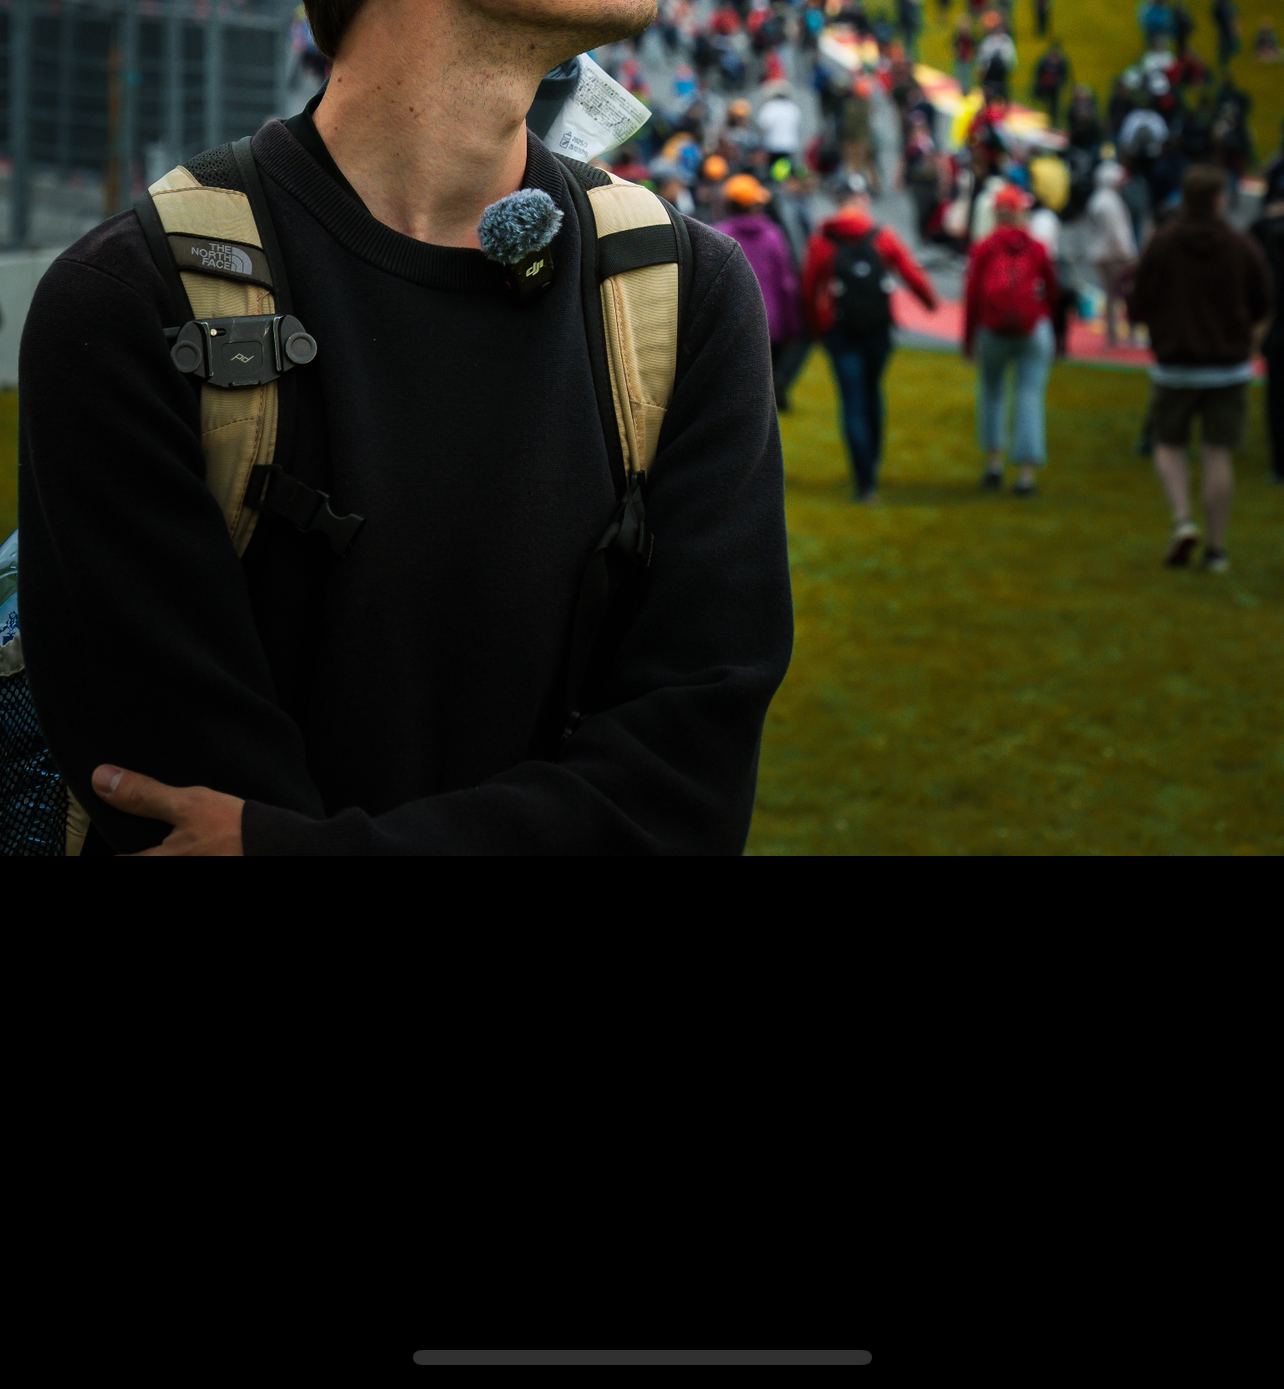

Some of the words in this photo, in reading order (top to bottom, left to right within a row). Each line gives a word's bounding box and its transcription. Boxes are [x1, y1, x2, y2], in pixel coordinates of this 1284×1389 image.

[191, 246, 231, 262] NORTH
[209, 243, 231, 254] THE
[202, 257, 230, 270] FACE
